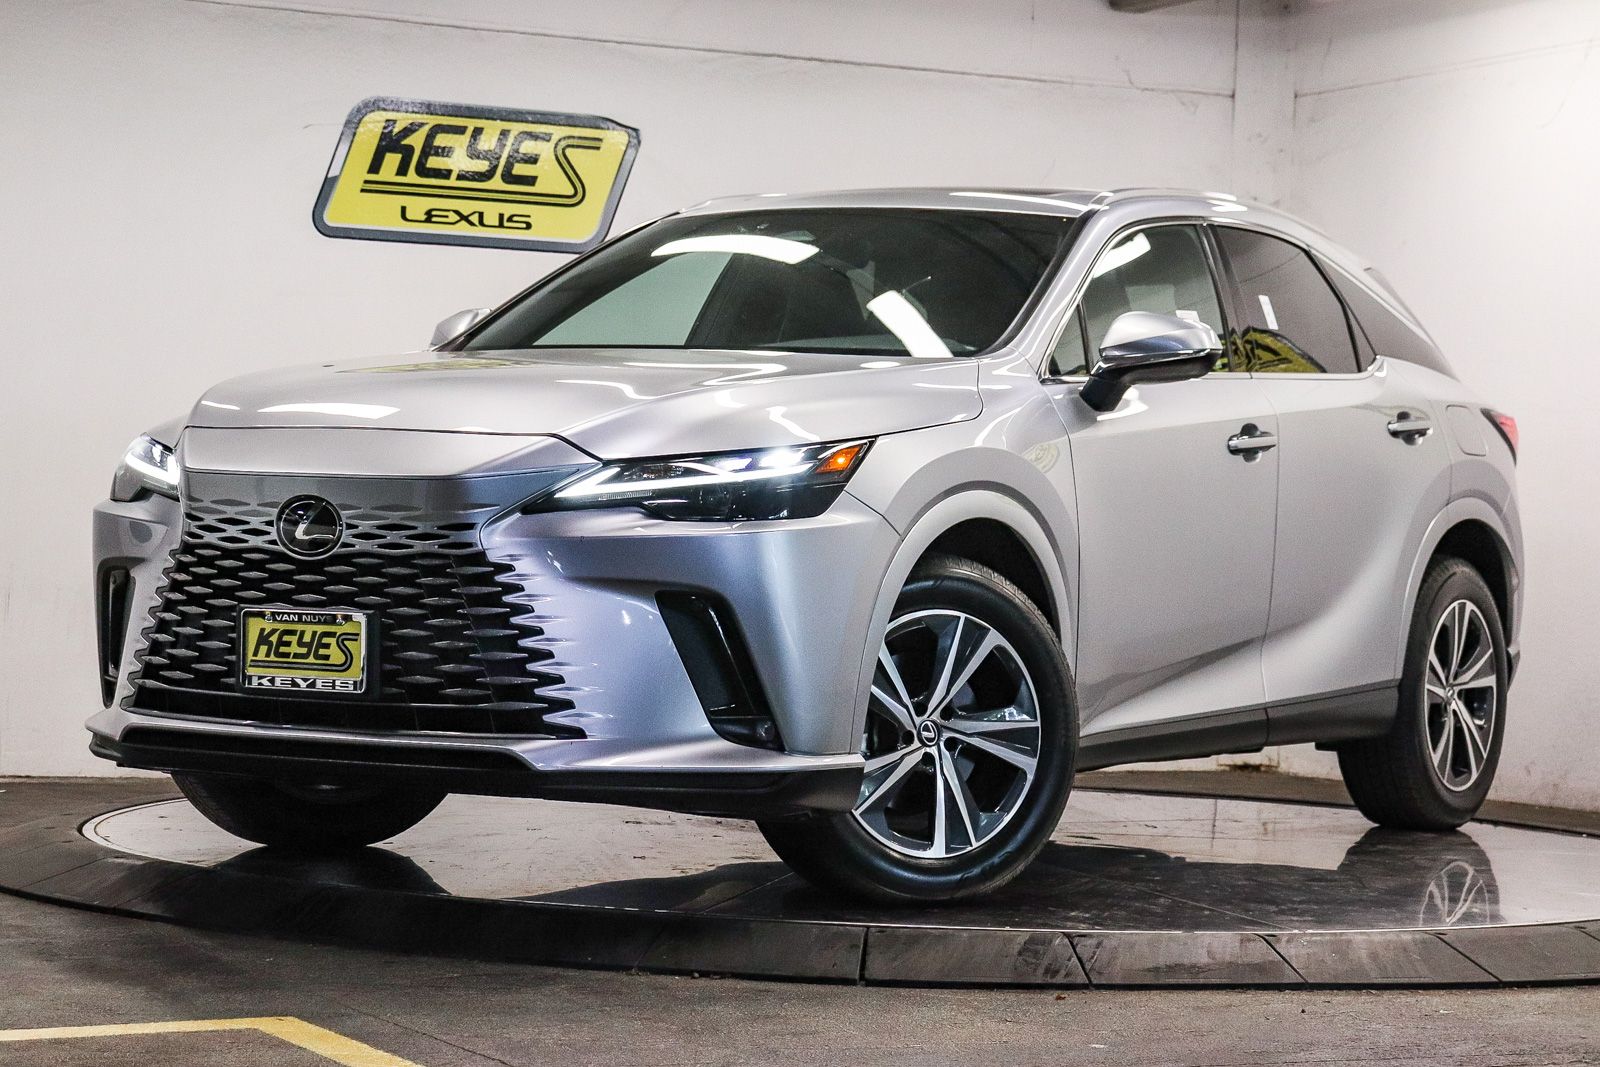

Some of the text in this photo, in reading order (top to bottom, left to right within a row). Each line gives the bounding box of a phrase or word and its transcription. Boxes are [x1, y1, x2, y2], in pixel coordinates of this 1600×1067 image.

[366, 118, 603, 207] KEYES
[400, 205, 533, 231] LEXUS
[274, 613, 299, 622] VAN
[251, 627, 360, 673] KEYES
[251, 676, 354, 691] KEYES
